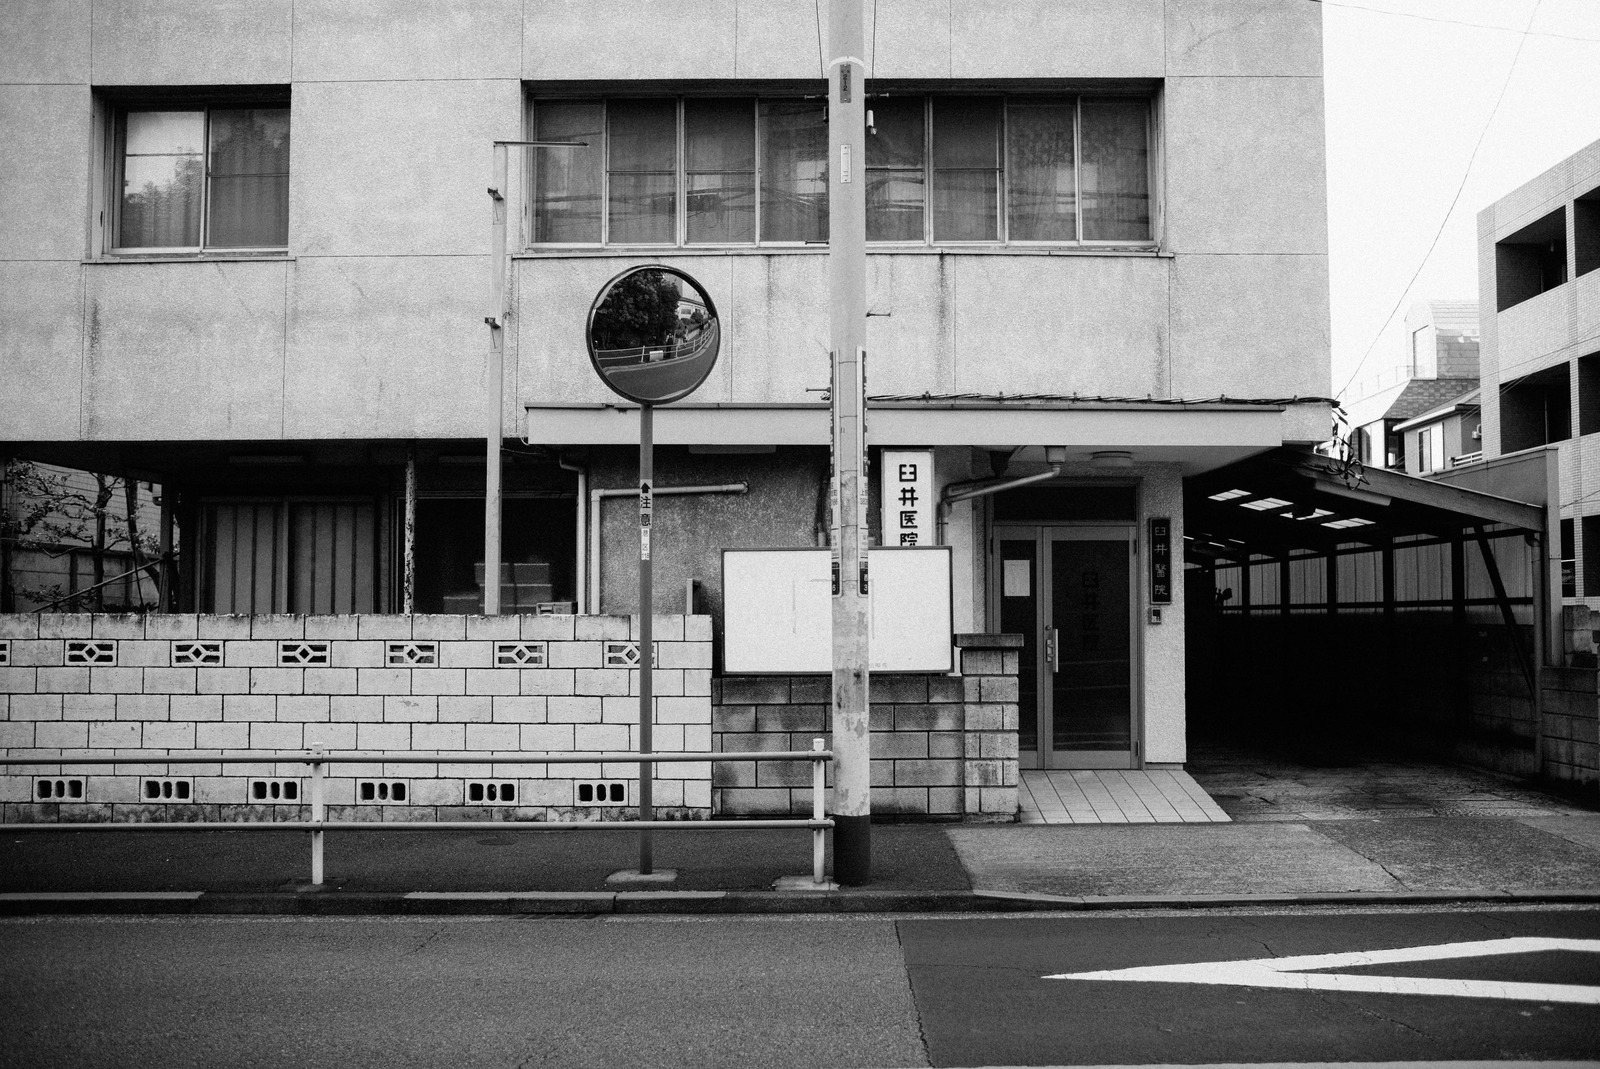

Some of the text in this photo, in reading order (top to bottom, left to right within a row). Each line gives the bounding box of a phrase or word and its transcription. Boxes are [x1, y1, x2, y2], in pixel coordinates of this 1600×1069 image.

[640, 495, 652, 527] 注意
[898, 464, 919, 546] 臼井医院
[1153, 526, 1168, 596] 臼井醫院
